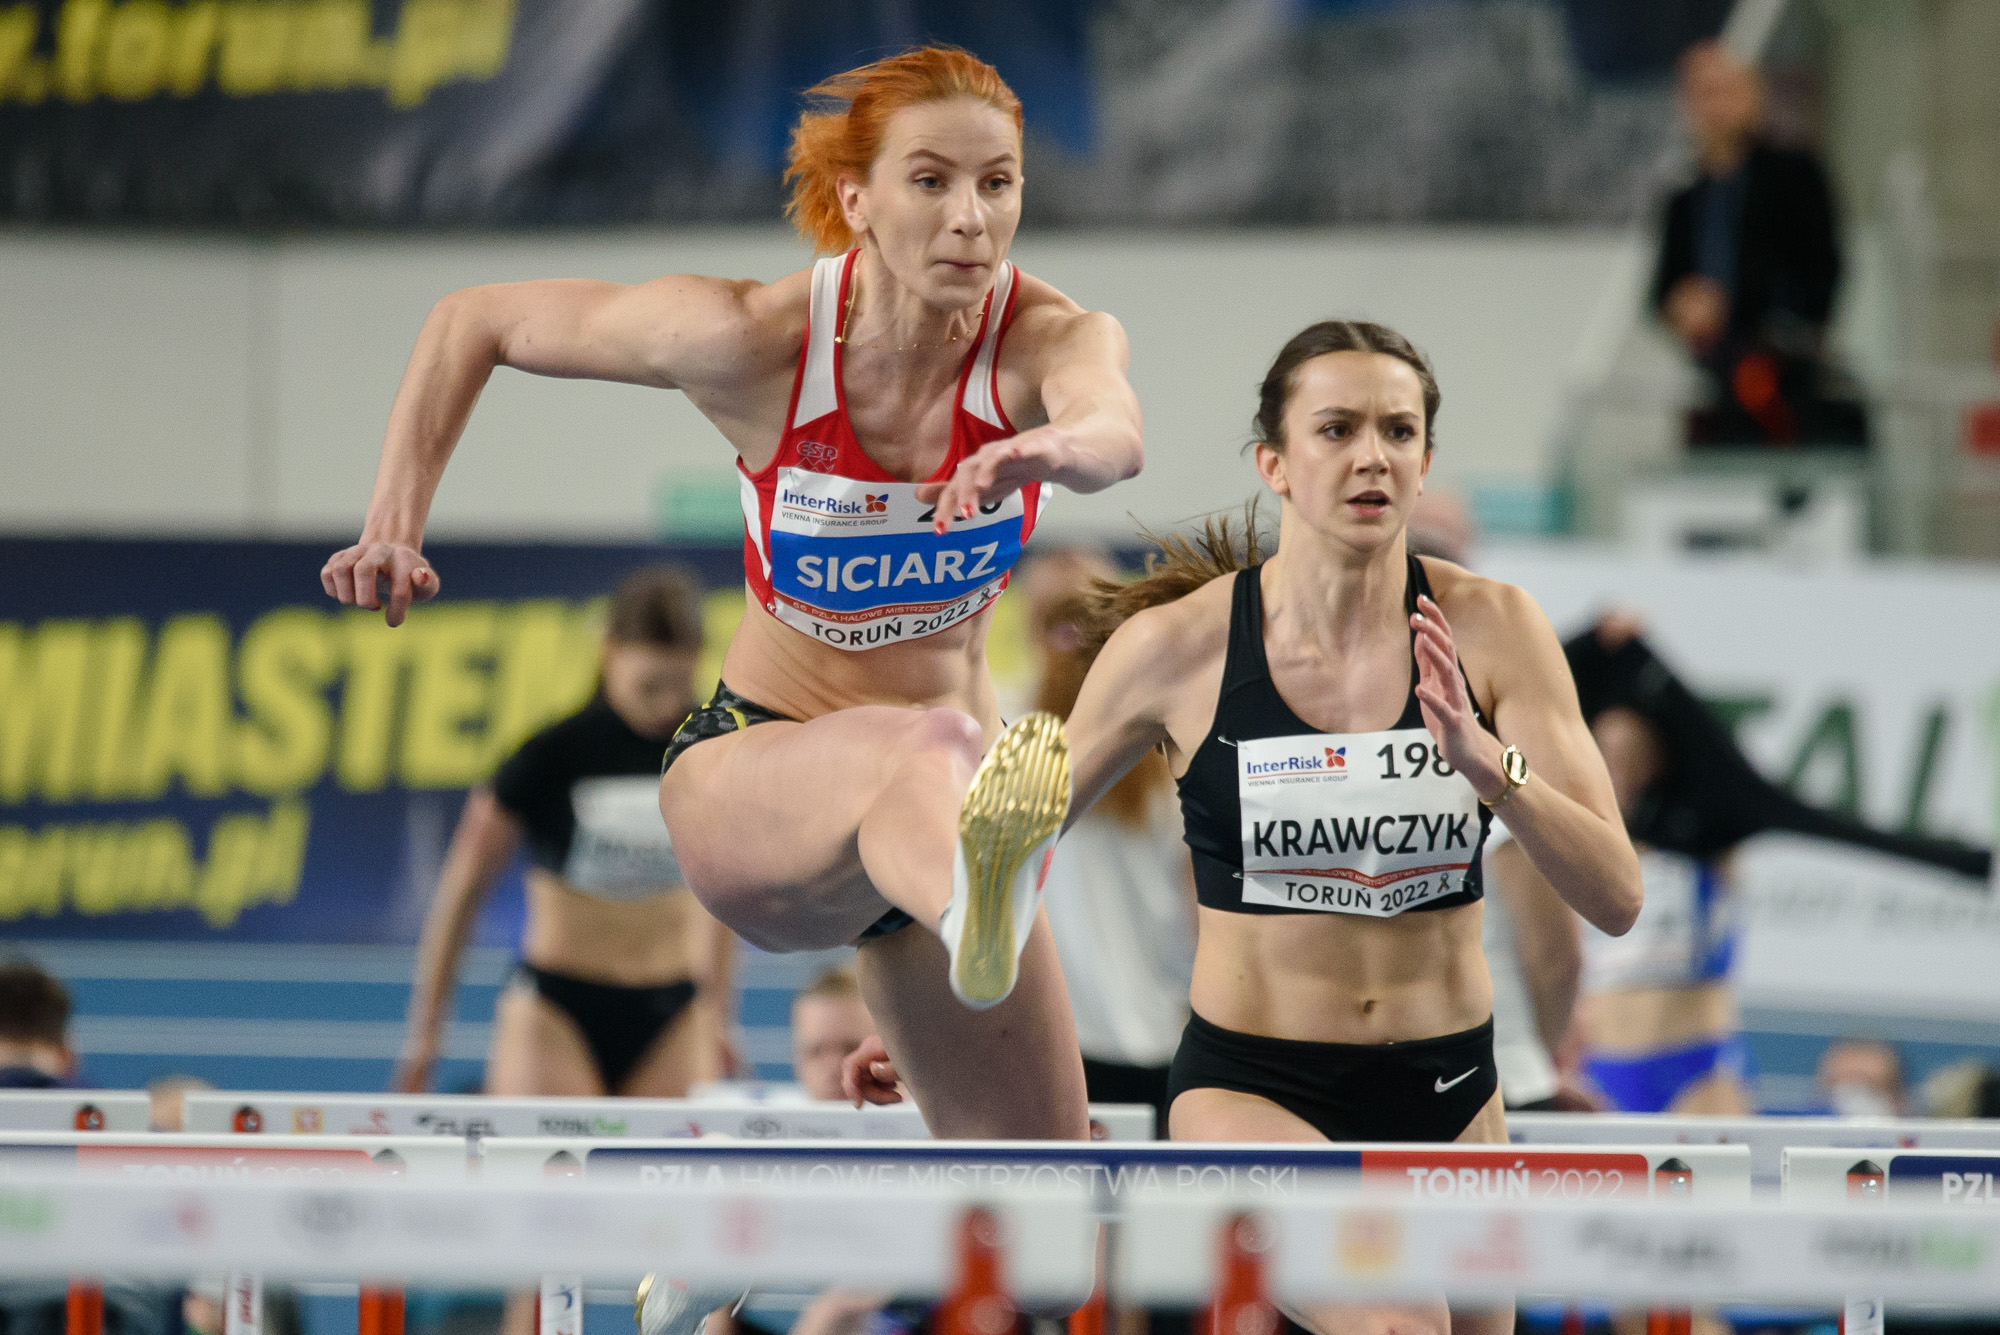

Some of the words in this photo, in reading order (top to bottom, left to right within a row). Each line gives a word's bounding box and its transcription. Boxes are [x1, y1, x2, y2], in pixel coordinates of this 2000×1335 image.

[783, 489, 862, 514] InterRisk
[782, 511, 811, 523] VIENNA
[812, 517, 858, 527] INSURANCE
[796, 540, 999, 593] SICIARZ
[812, 609, 838, 621] PZLA
[841, 609, 883, 622] HALOWE
[812, 616, 902, 646] TORUŃ
[912, 601, 969, 635] 2022
[1247, 756, 1323, 774] InterRisk
[1376, 742, 1456, 780] 198
[1248, 779, 1276, 787] VIENNA
[1278, 776, 1321, 785] INSURANCE
[1322, 775, 1348, 783] GROUP
[1253, 813, 1469, 858] KRAWCZYK
[1285, 881, 1372, 909] TORUŃ
[1380, 880, 1429, 911] 2022
[1177, 1166, 1299, 1197] POLSKI
[1407, 1160, 1530, 1199] TORUŃ
[1541, 1169, 1624, 1199] 2022
